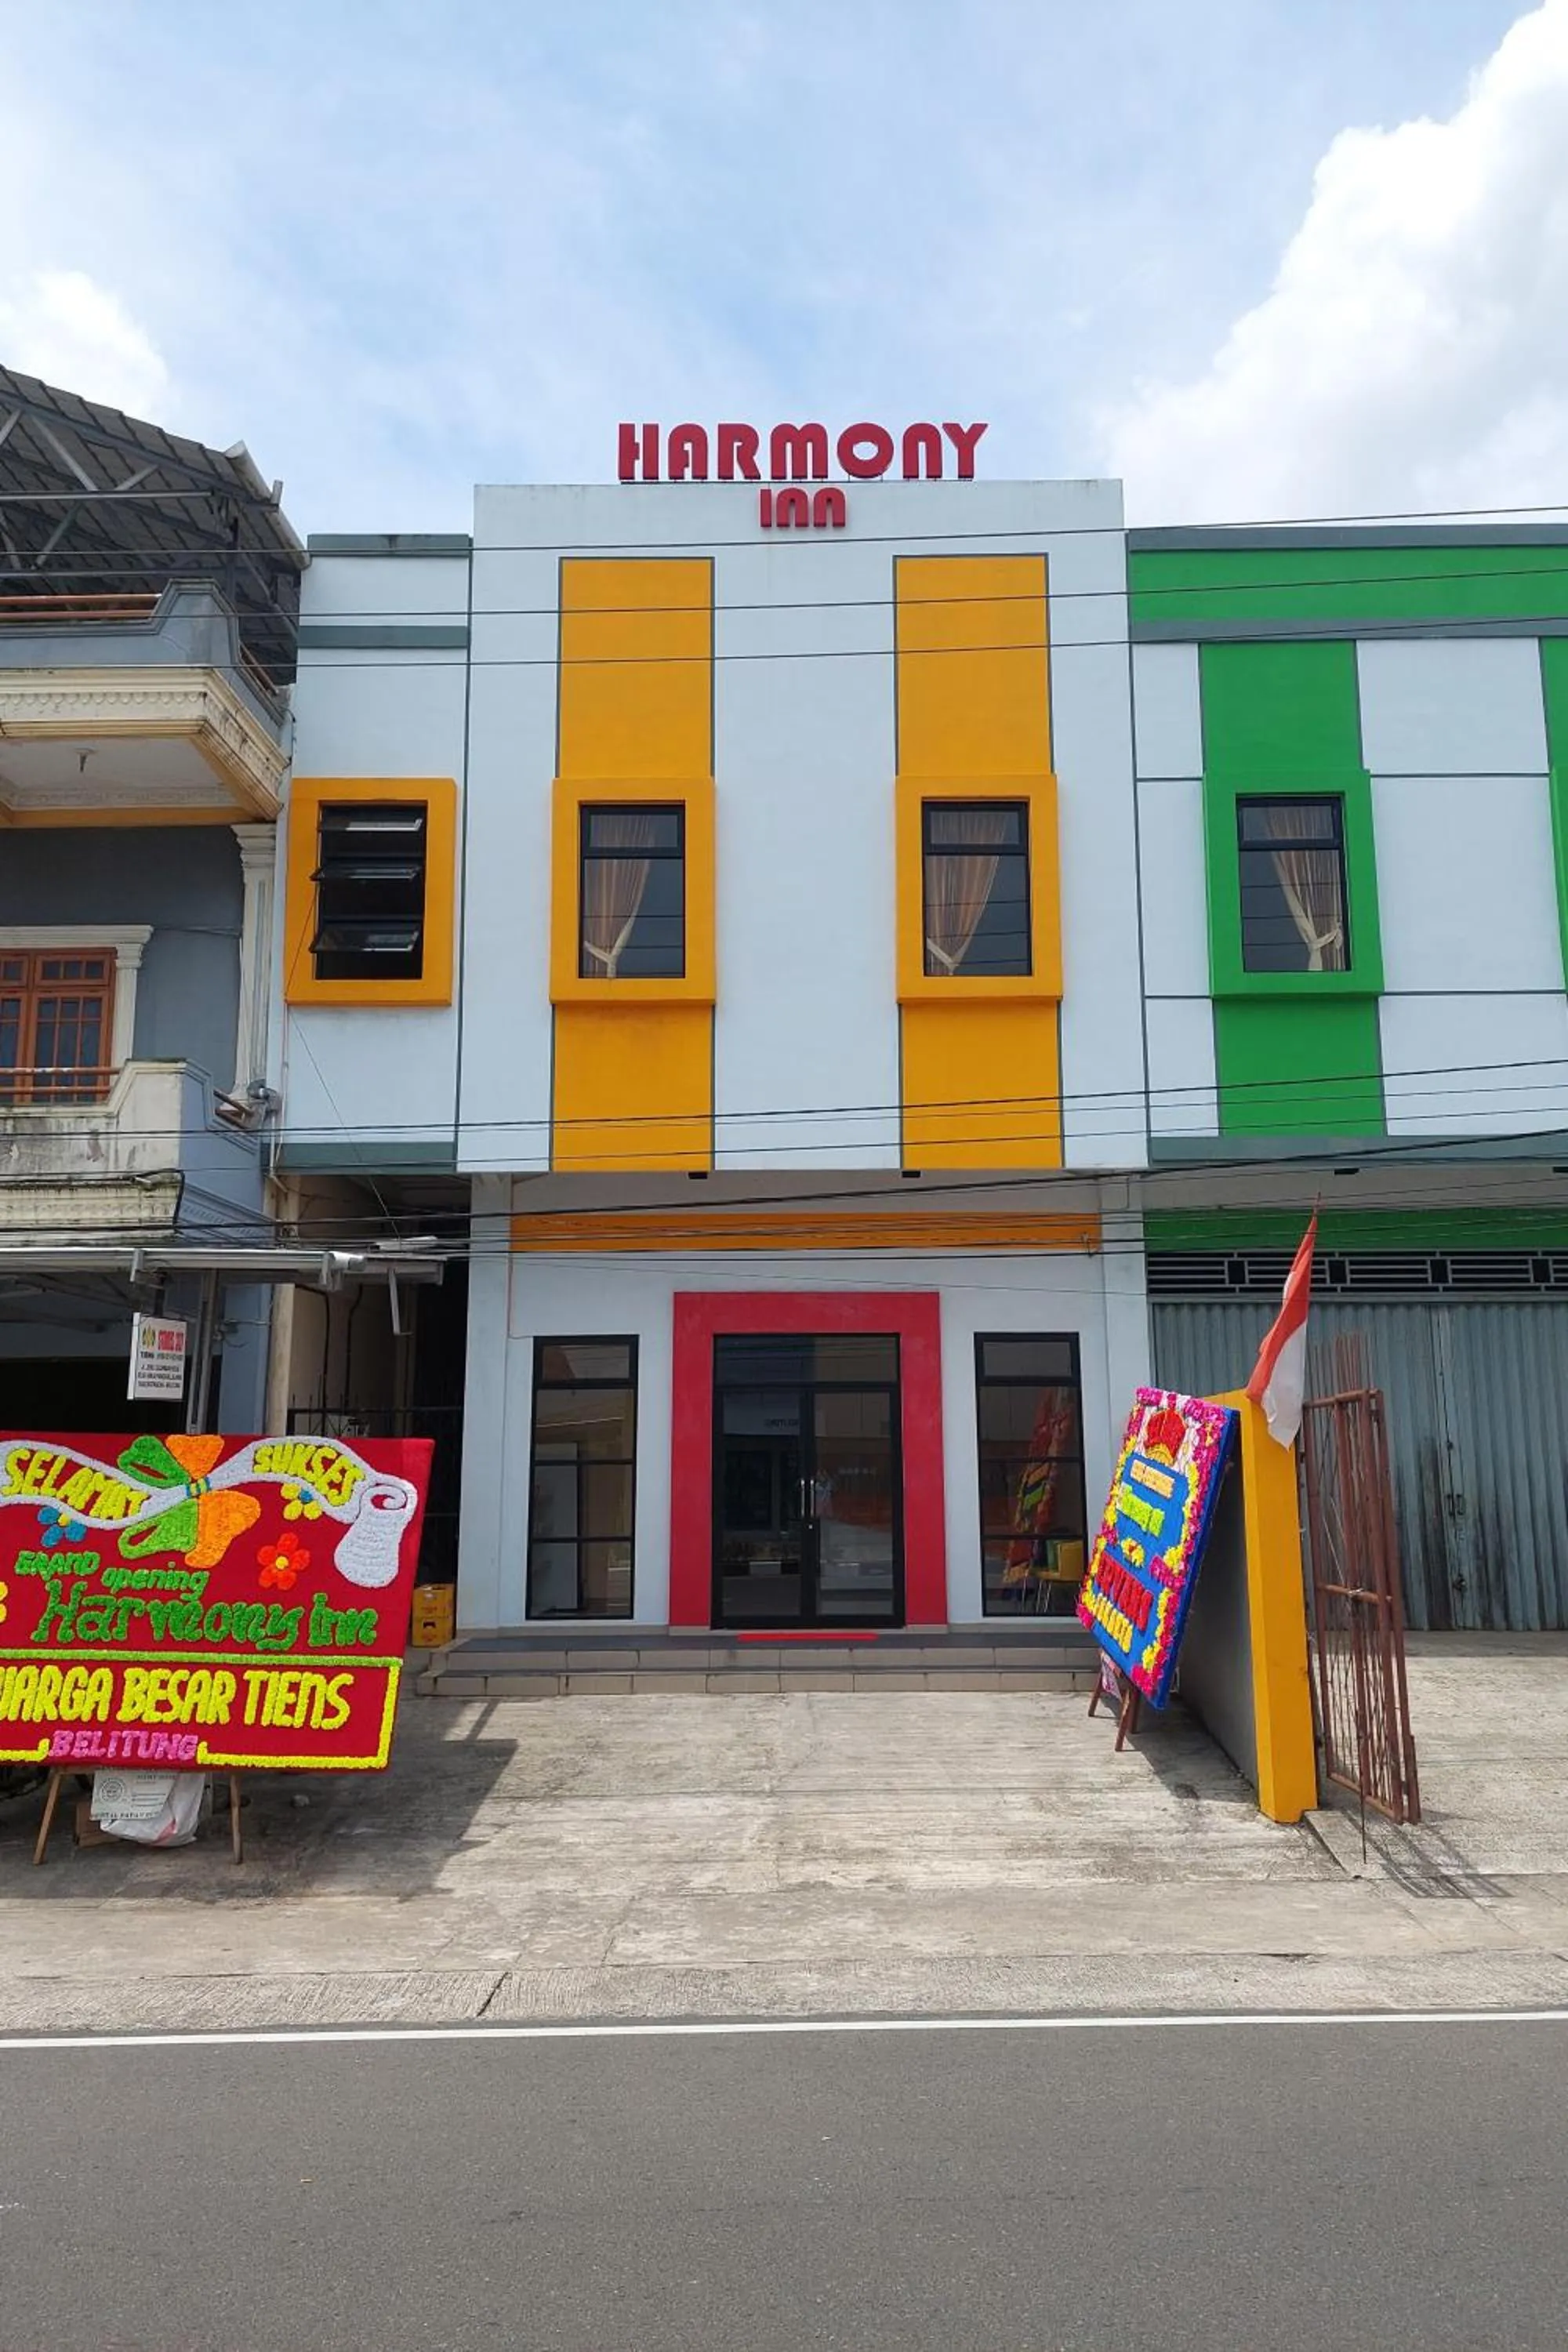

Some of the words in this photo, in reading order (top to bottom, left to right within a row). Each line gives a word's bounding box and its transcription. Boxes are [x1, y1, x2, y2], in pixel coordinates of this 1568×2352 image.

[618, 422, 988, 481] HARMONY
[760, 488, 846, 528] INN
[2, 1448, 152, 1520] SELAMAT
[253, 1443, 365, 1507] SUKSES
[101, 1561, 210, 1602] opening
[31, 1579, 305, 1650] Harmony
[115, 1668, 236, 1724] BESAR
[243, 1671, 354, 1730] TIENS
[49, 1730, 199, 1761] BELITUNG
